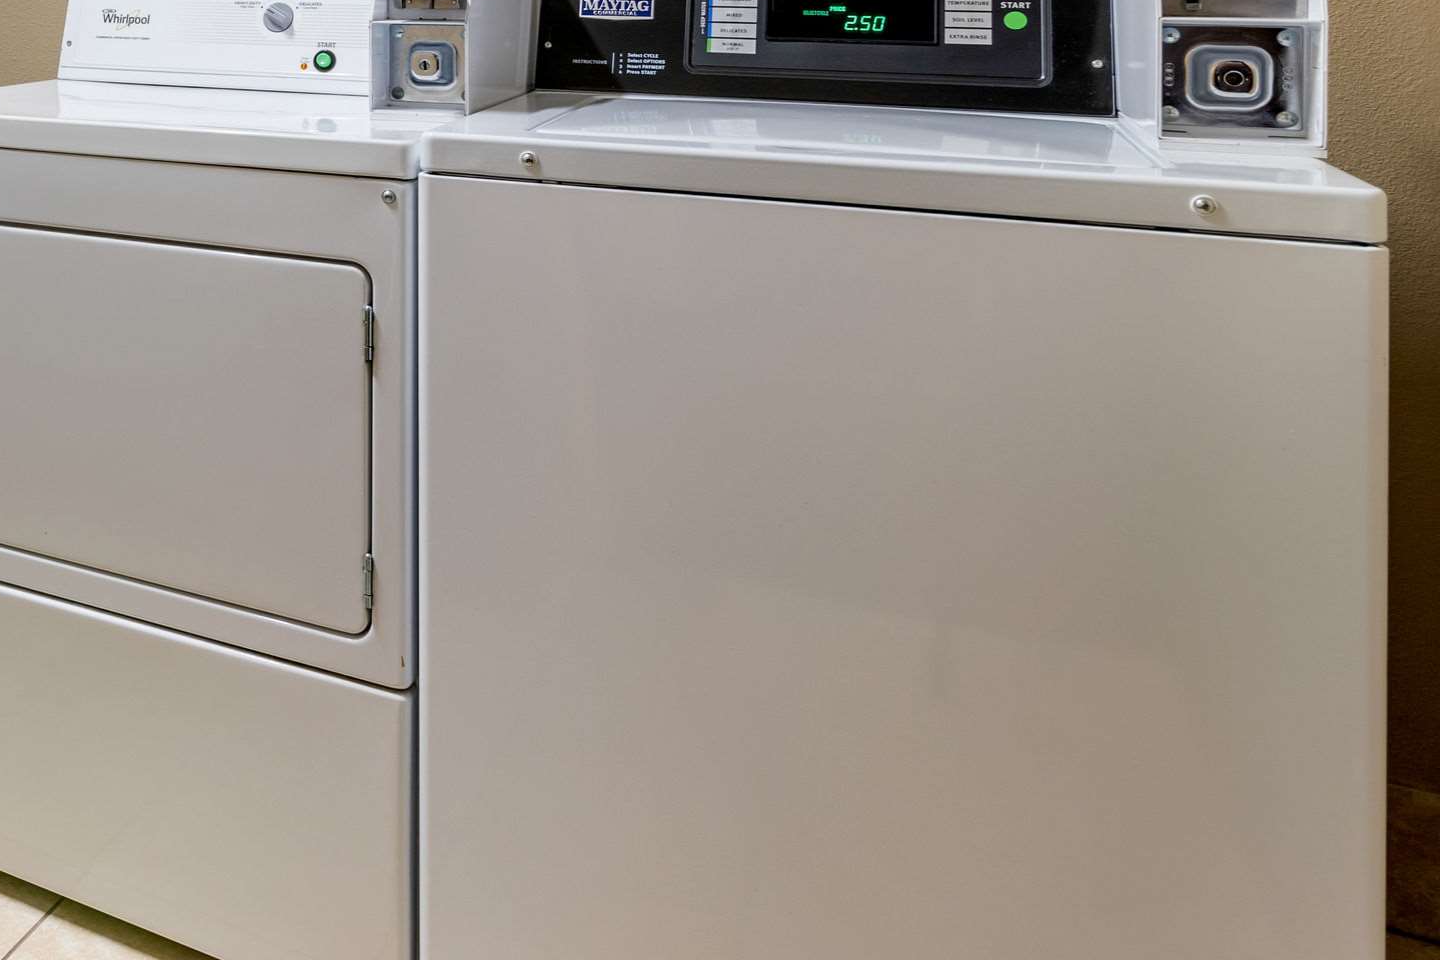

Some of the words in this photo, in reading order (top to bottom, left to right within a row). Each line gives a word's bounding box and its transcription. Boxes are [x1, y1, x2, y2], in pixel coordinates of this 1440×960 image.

[584, 0, 650, 12] MAYTAG
[103, 13, 150, 26] Whirlpool
[844, 16, 886, 32] 2.50
